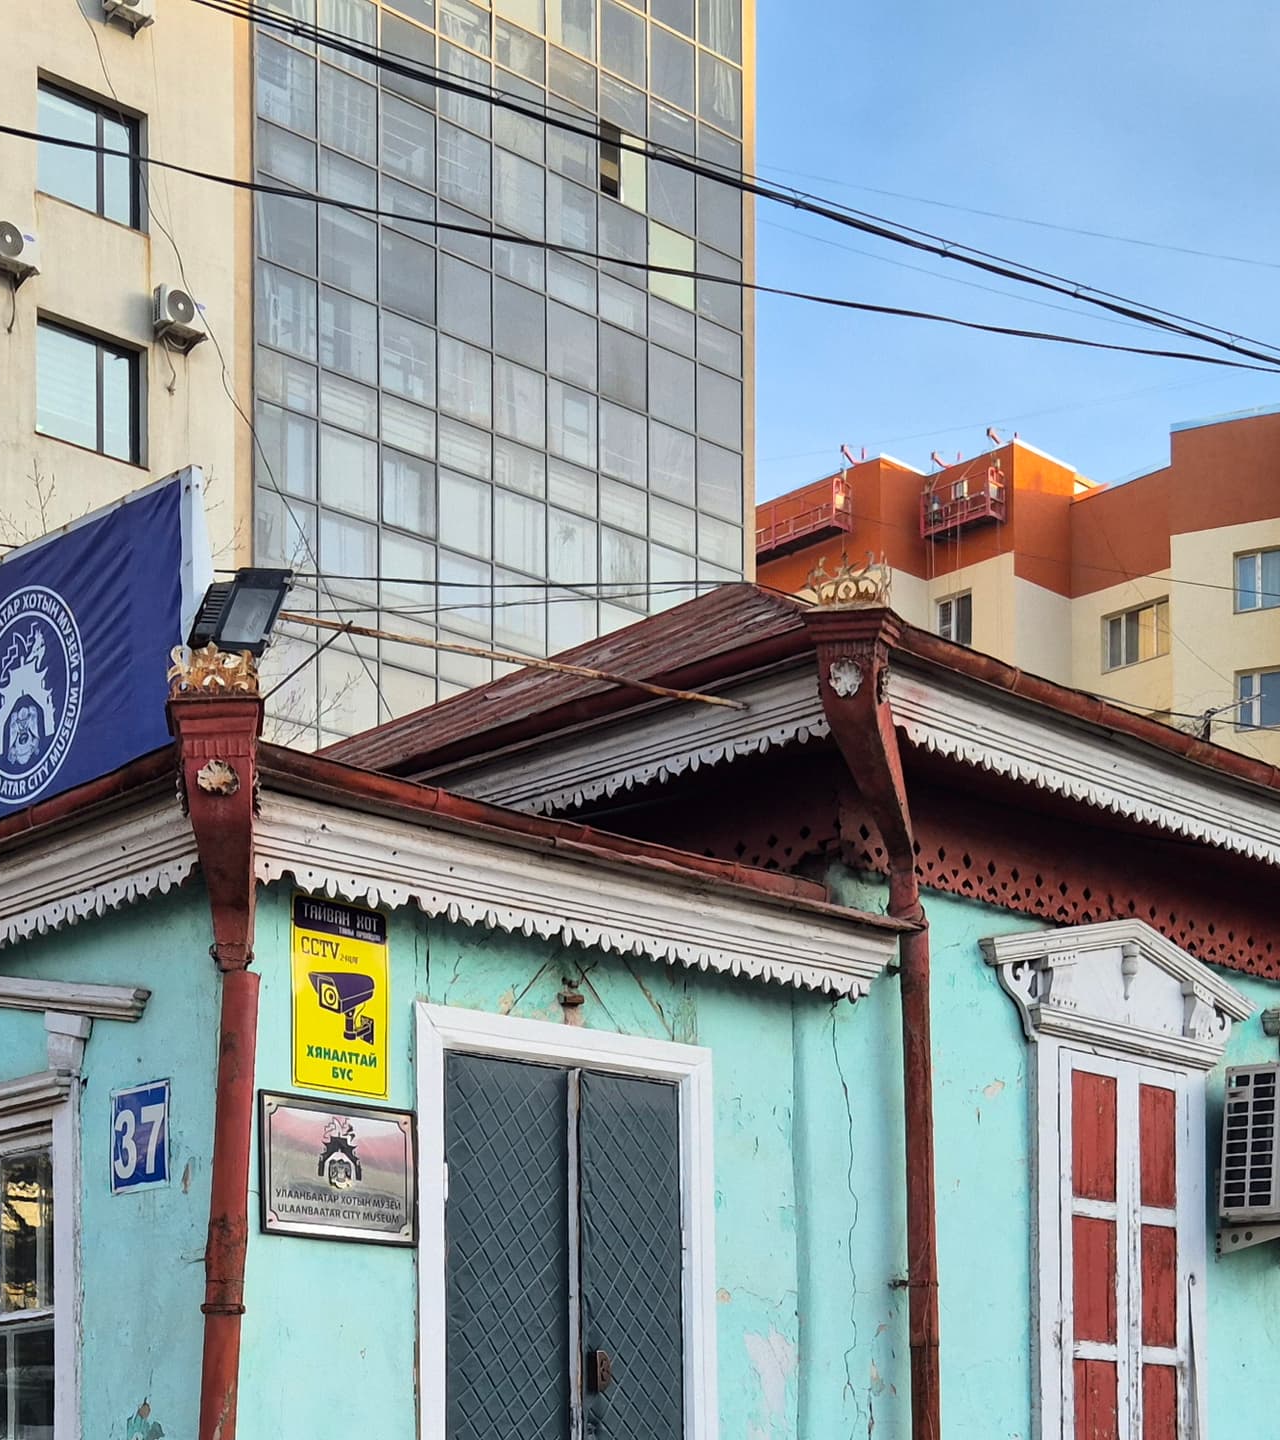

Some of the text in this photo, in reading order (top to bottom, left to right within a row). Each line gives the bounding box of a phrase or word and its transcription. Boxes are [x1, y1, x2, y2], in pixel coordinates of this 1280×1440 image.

[21, 592, 61, 620] ХОТЫН
[56, 610, 81, 669] МУЗЕЙ
[25, 764, 51, 792] CITY
[50, 687, 80, 769] MUSEUM
[301, 902, 379, 932] ТАЙВАН ХОТ
[301, 936, 340, 960] CCTV
[306, 1044, 377, 1068] ХЯНАЛТТАЙ
[332, 1066, 354, 1081] БҮС
[112, 1102, 168, 1180] 37
[275, 1188, 401, 1211] УЛААНБААТАР ХОТЫН МУЗЕЙ
[277, 1203, 400, 1225] ULAANBAATAR CITY MUSEUM
